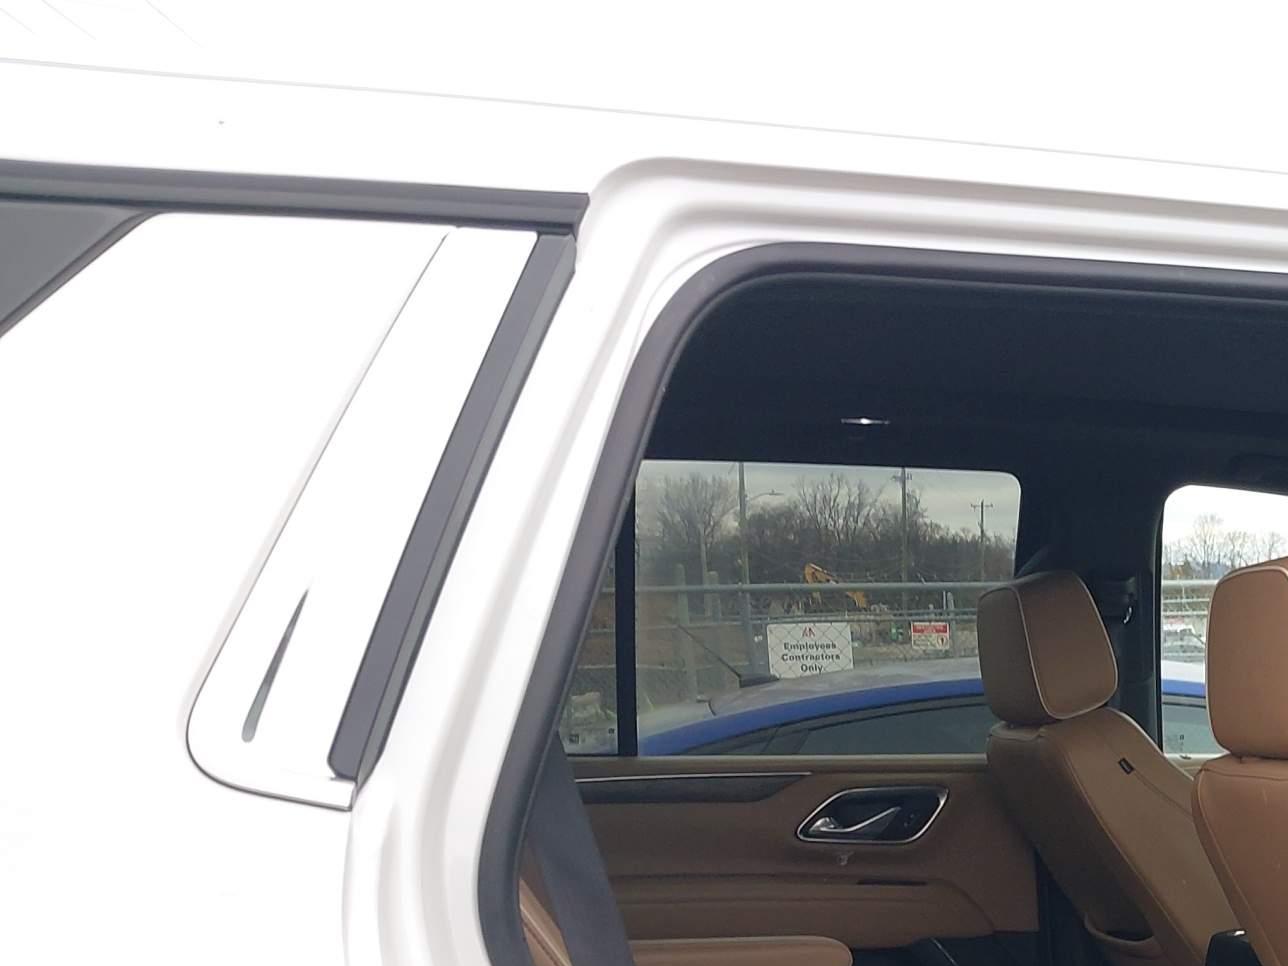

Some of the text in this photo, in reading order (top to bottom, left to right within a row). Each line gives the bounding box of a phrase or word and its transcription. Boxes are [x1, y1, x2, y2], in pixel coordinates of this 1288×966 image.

[783, 642, 837, 651] Employees
[781, 653, 841, 662] Contractors
[800, 663, 823, 675] Only
